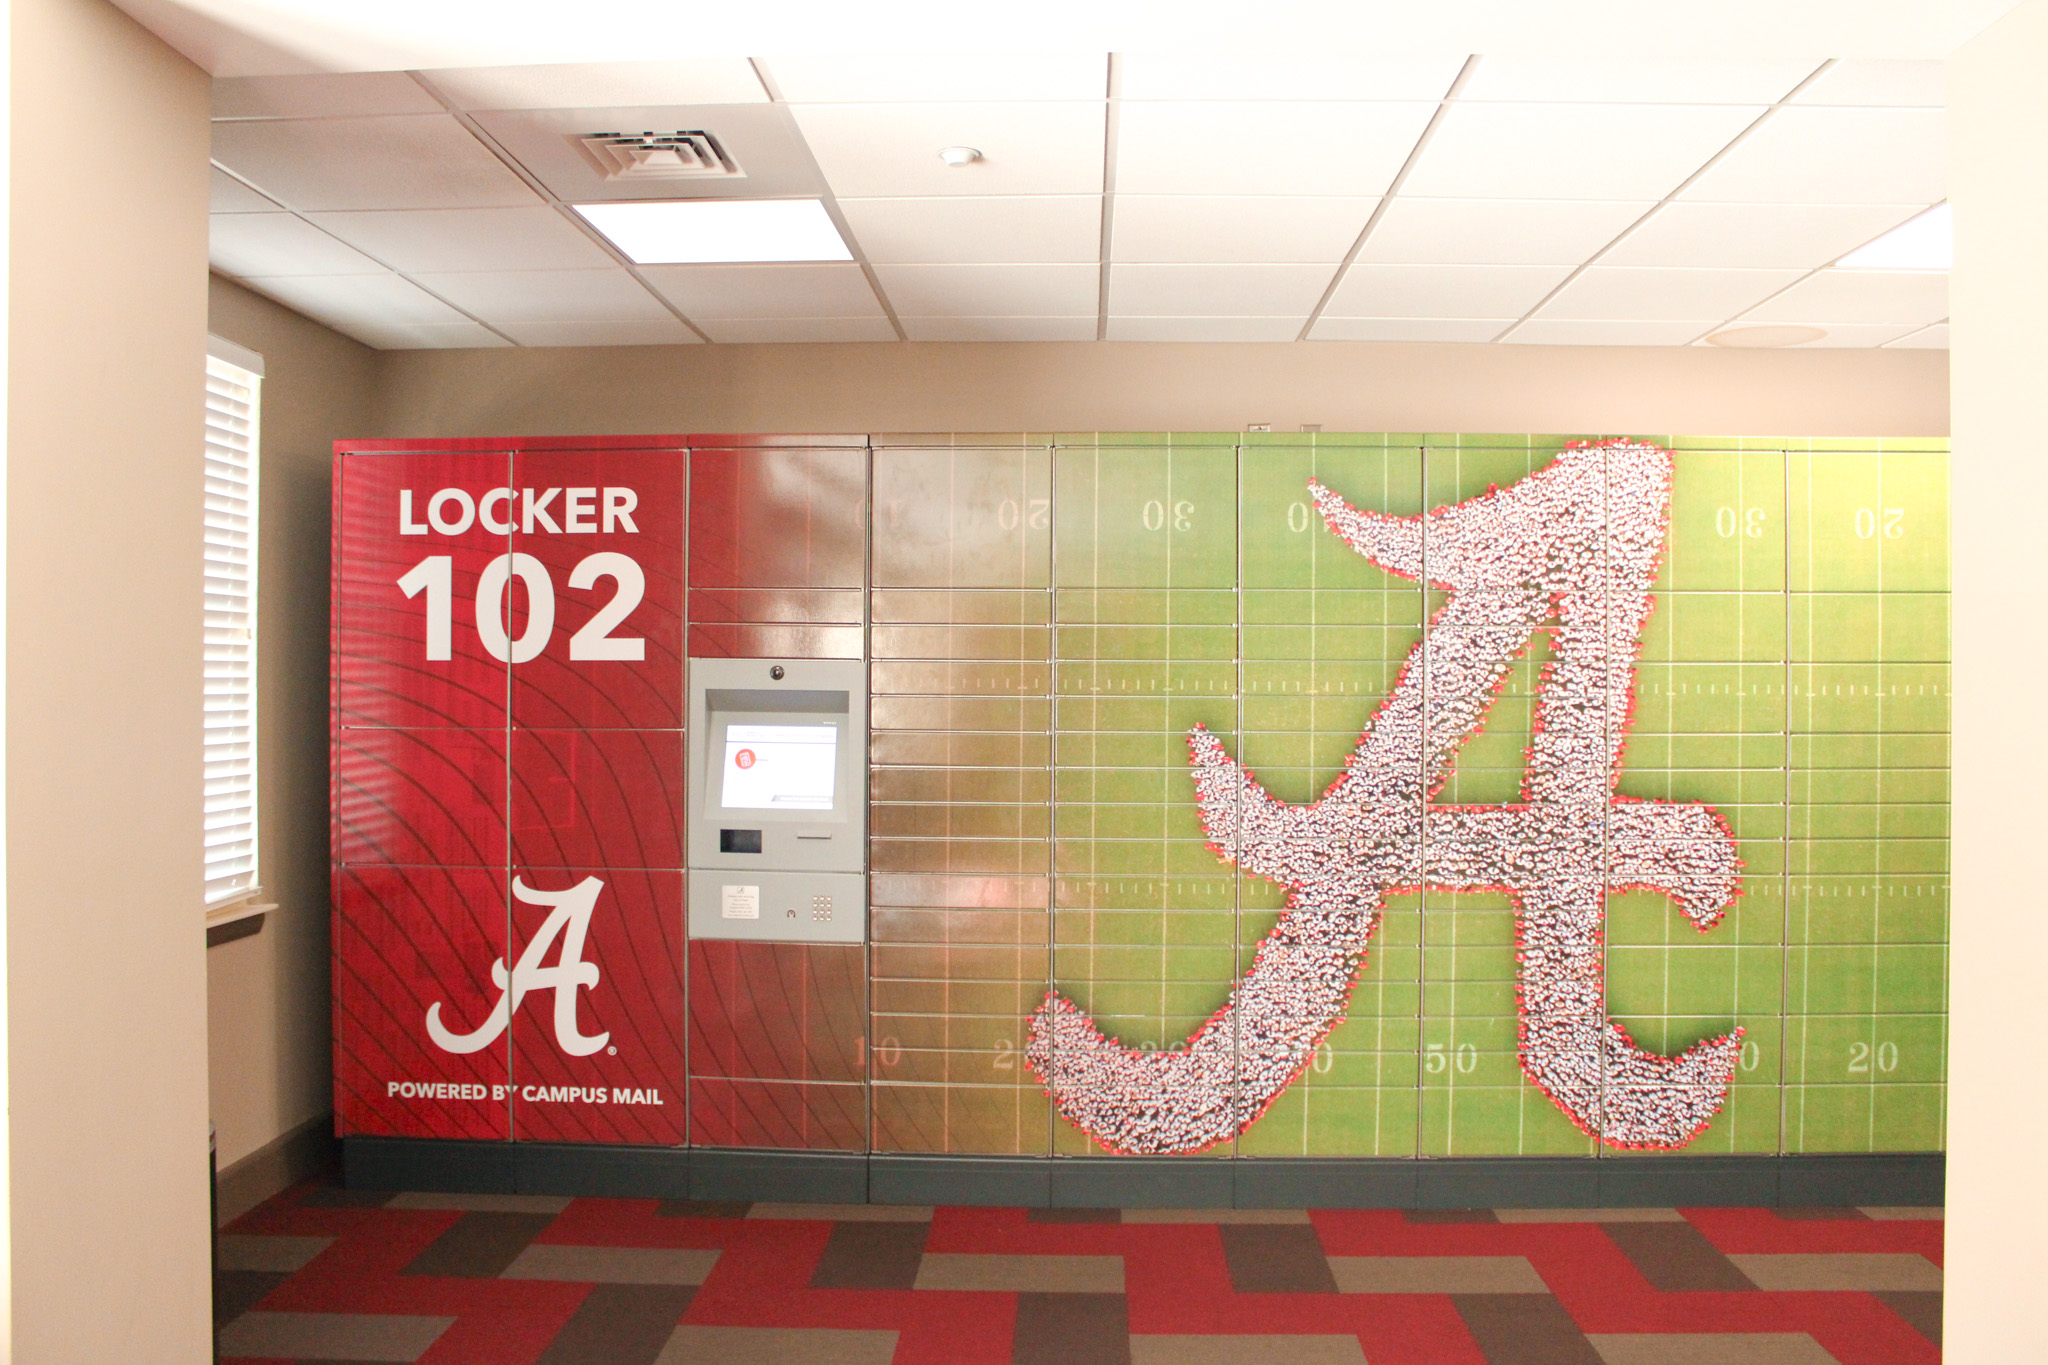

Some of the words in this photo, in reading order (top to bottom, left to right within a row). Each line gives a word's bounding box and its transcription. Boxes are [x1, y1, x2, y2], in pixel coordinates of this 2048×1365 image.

[400, 487, 640, 536] LOCKER
[396, 552, 646, 664] 102
[1425, 1043, 1478, 1074] 50
[1848, 1042, 1899, 1073] 20
[387, 1082, 487, 1101] POWERED
[492, 1084, 519, 1101] BY
[522, 1085, 608, 1104] CAMPUS
[612, 1088, 664, 1105] MAIL
